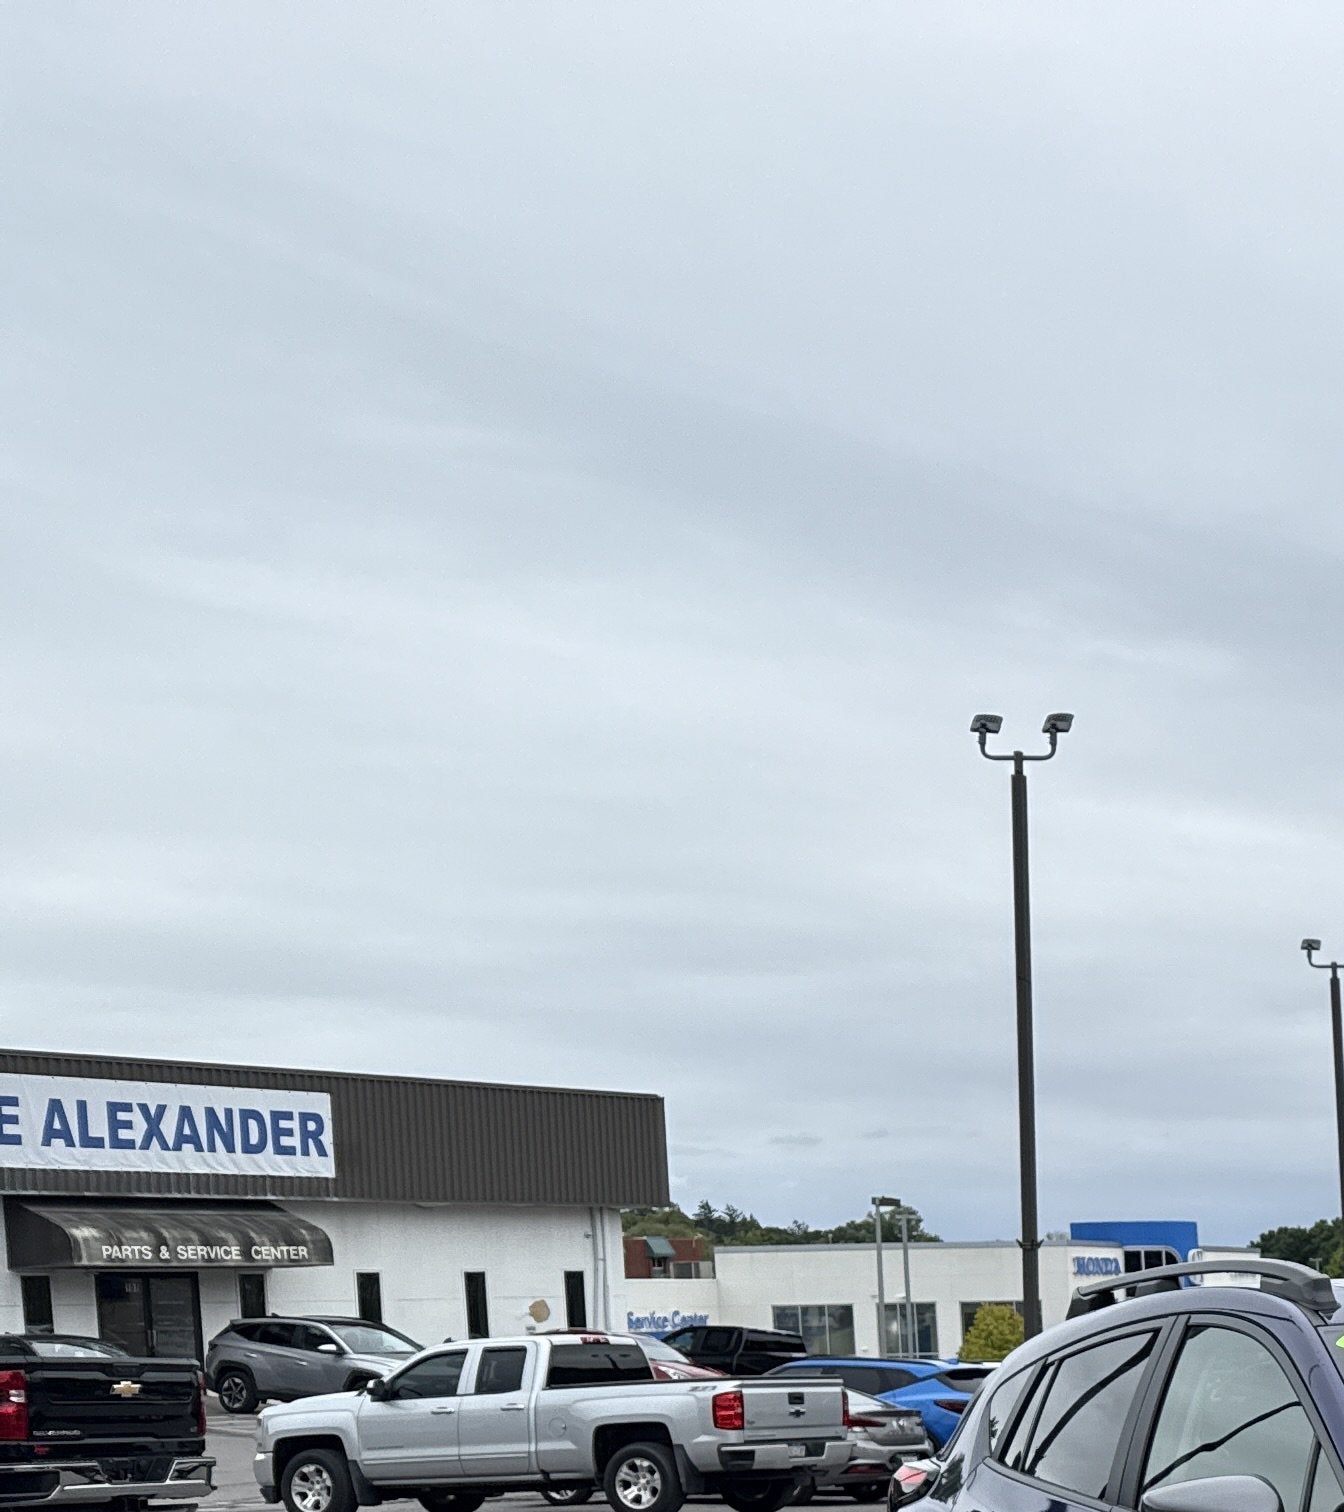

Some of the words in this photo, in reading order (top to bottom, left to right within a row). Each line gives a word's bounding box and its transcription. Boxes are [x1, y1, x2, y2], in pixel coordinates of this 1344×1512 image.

[41, 1097, 329, 1158] ALEXANDER
[102, 1245, 152, 1260] PARTS
[159, 1245, 170, 1260] &
[177, 1245, 241, 1260] SERVICE
[251, 1245, 309, 1260] CENTER
[1073, 1257, 1121, 1275] HONDA
[627, 1311, 668, 1329] Service
[672, 1310, 709, 1328] Center
